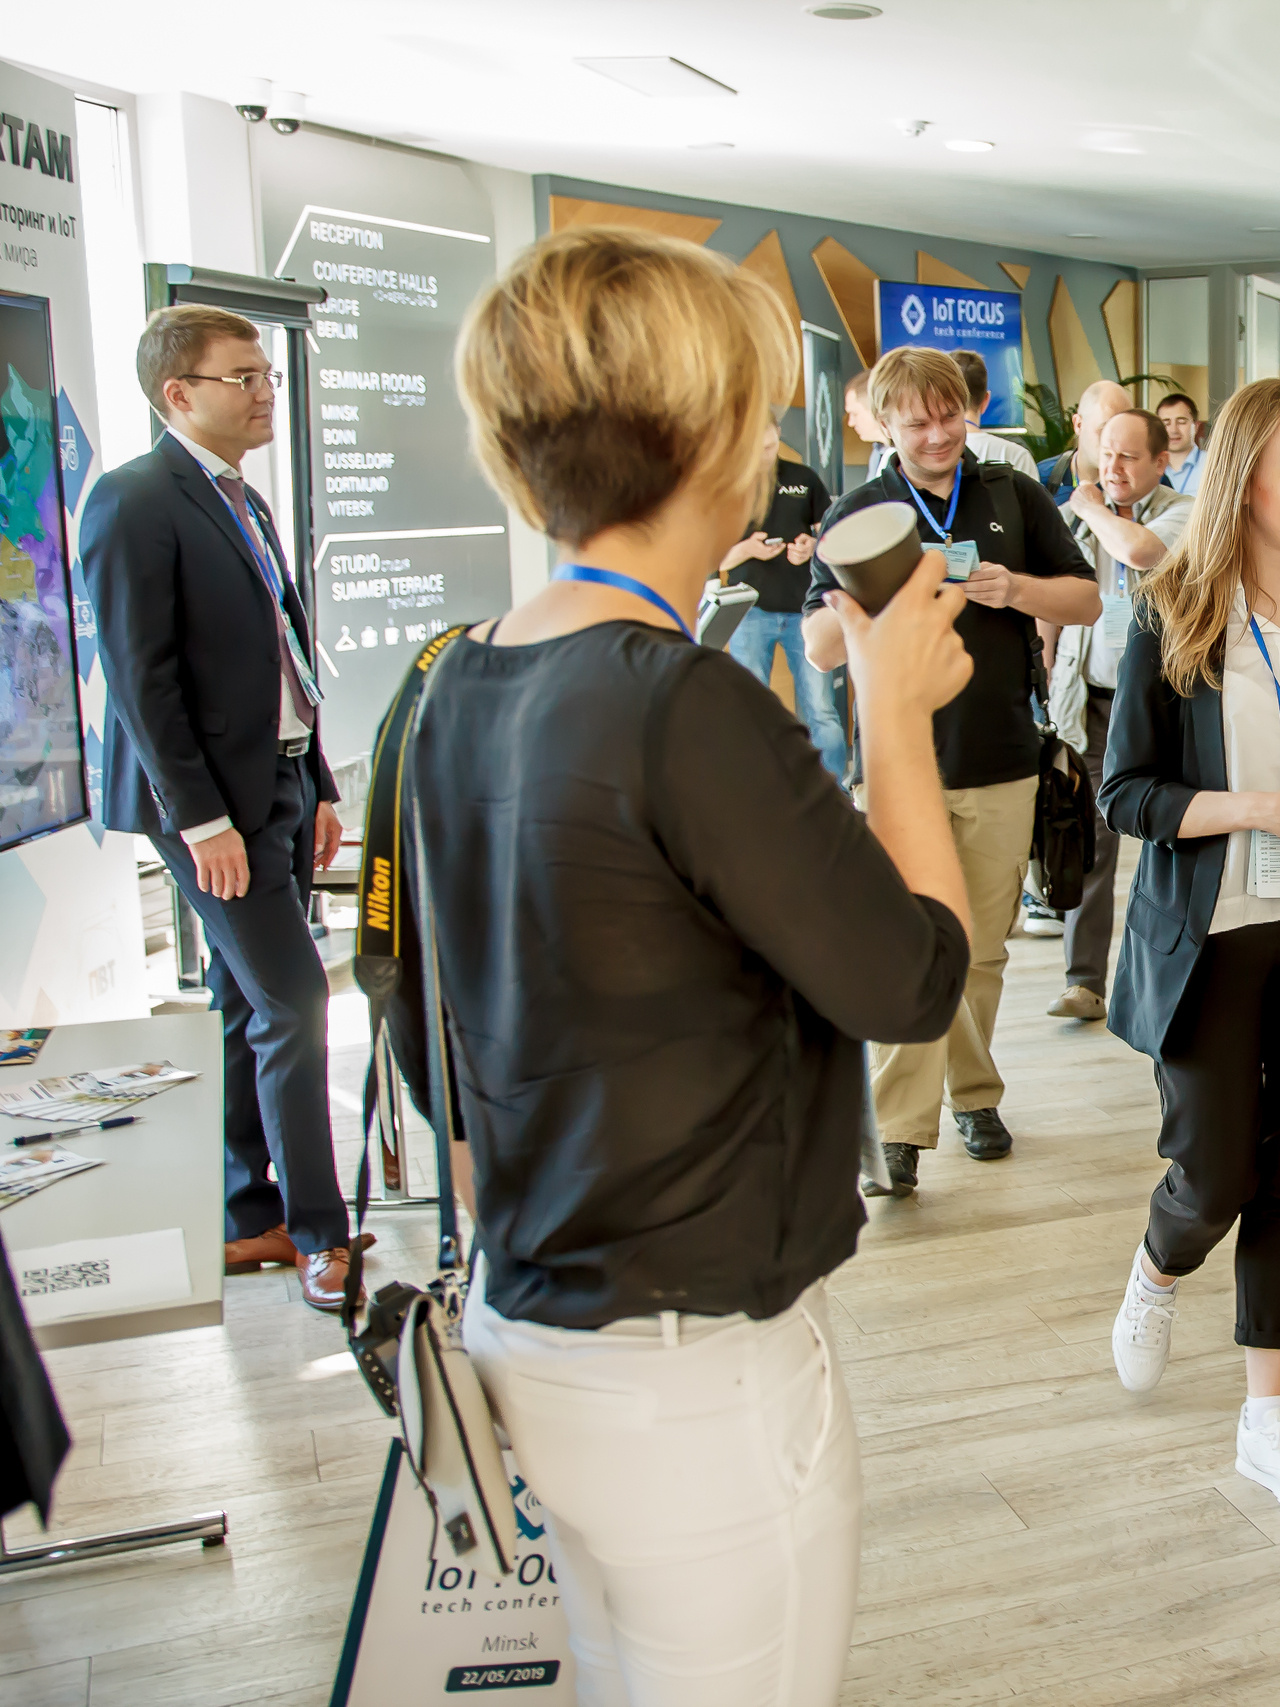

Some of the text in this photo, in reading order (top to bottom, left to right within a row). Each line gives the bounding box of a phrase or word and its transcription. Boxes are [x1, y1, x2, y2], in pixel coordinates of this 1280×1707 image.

[0, 113, 74, 183] TAM
[0, 202, 45, 232] торинг
[310, 220, 384, 250] RECEPTION
[4, 242, 38, 271] мира
[313, 260, 438, 295] CONFERENCE HALLS
[932, 297, 1005, 325] IoT FOCUS
[316, 319, 358, 340] BERLIN
[320, 368, 426, 394] SEMINAR ROOMS
[321, 404, 360, 422] MINSK
[323, 427, 357, 445] BONN
[325, 475, 390, 494] DORTMUND
[327, 499, 375, 518] VITEBSK
[330, 552, 380, 576] STUDIO
[332, 577, 391, 602] SUMMER
[391, 573, 445, 596] TERRACE
[405, 622, 427, 643] WC
[367, 856, 391, 931] Nikon
[420, 1597, 473, 1615] tech
[481, 1631, 540, 1653] Minsk
[460, 1666, 546, 1686] 22/05/2019
